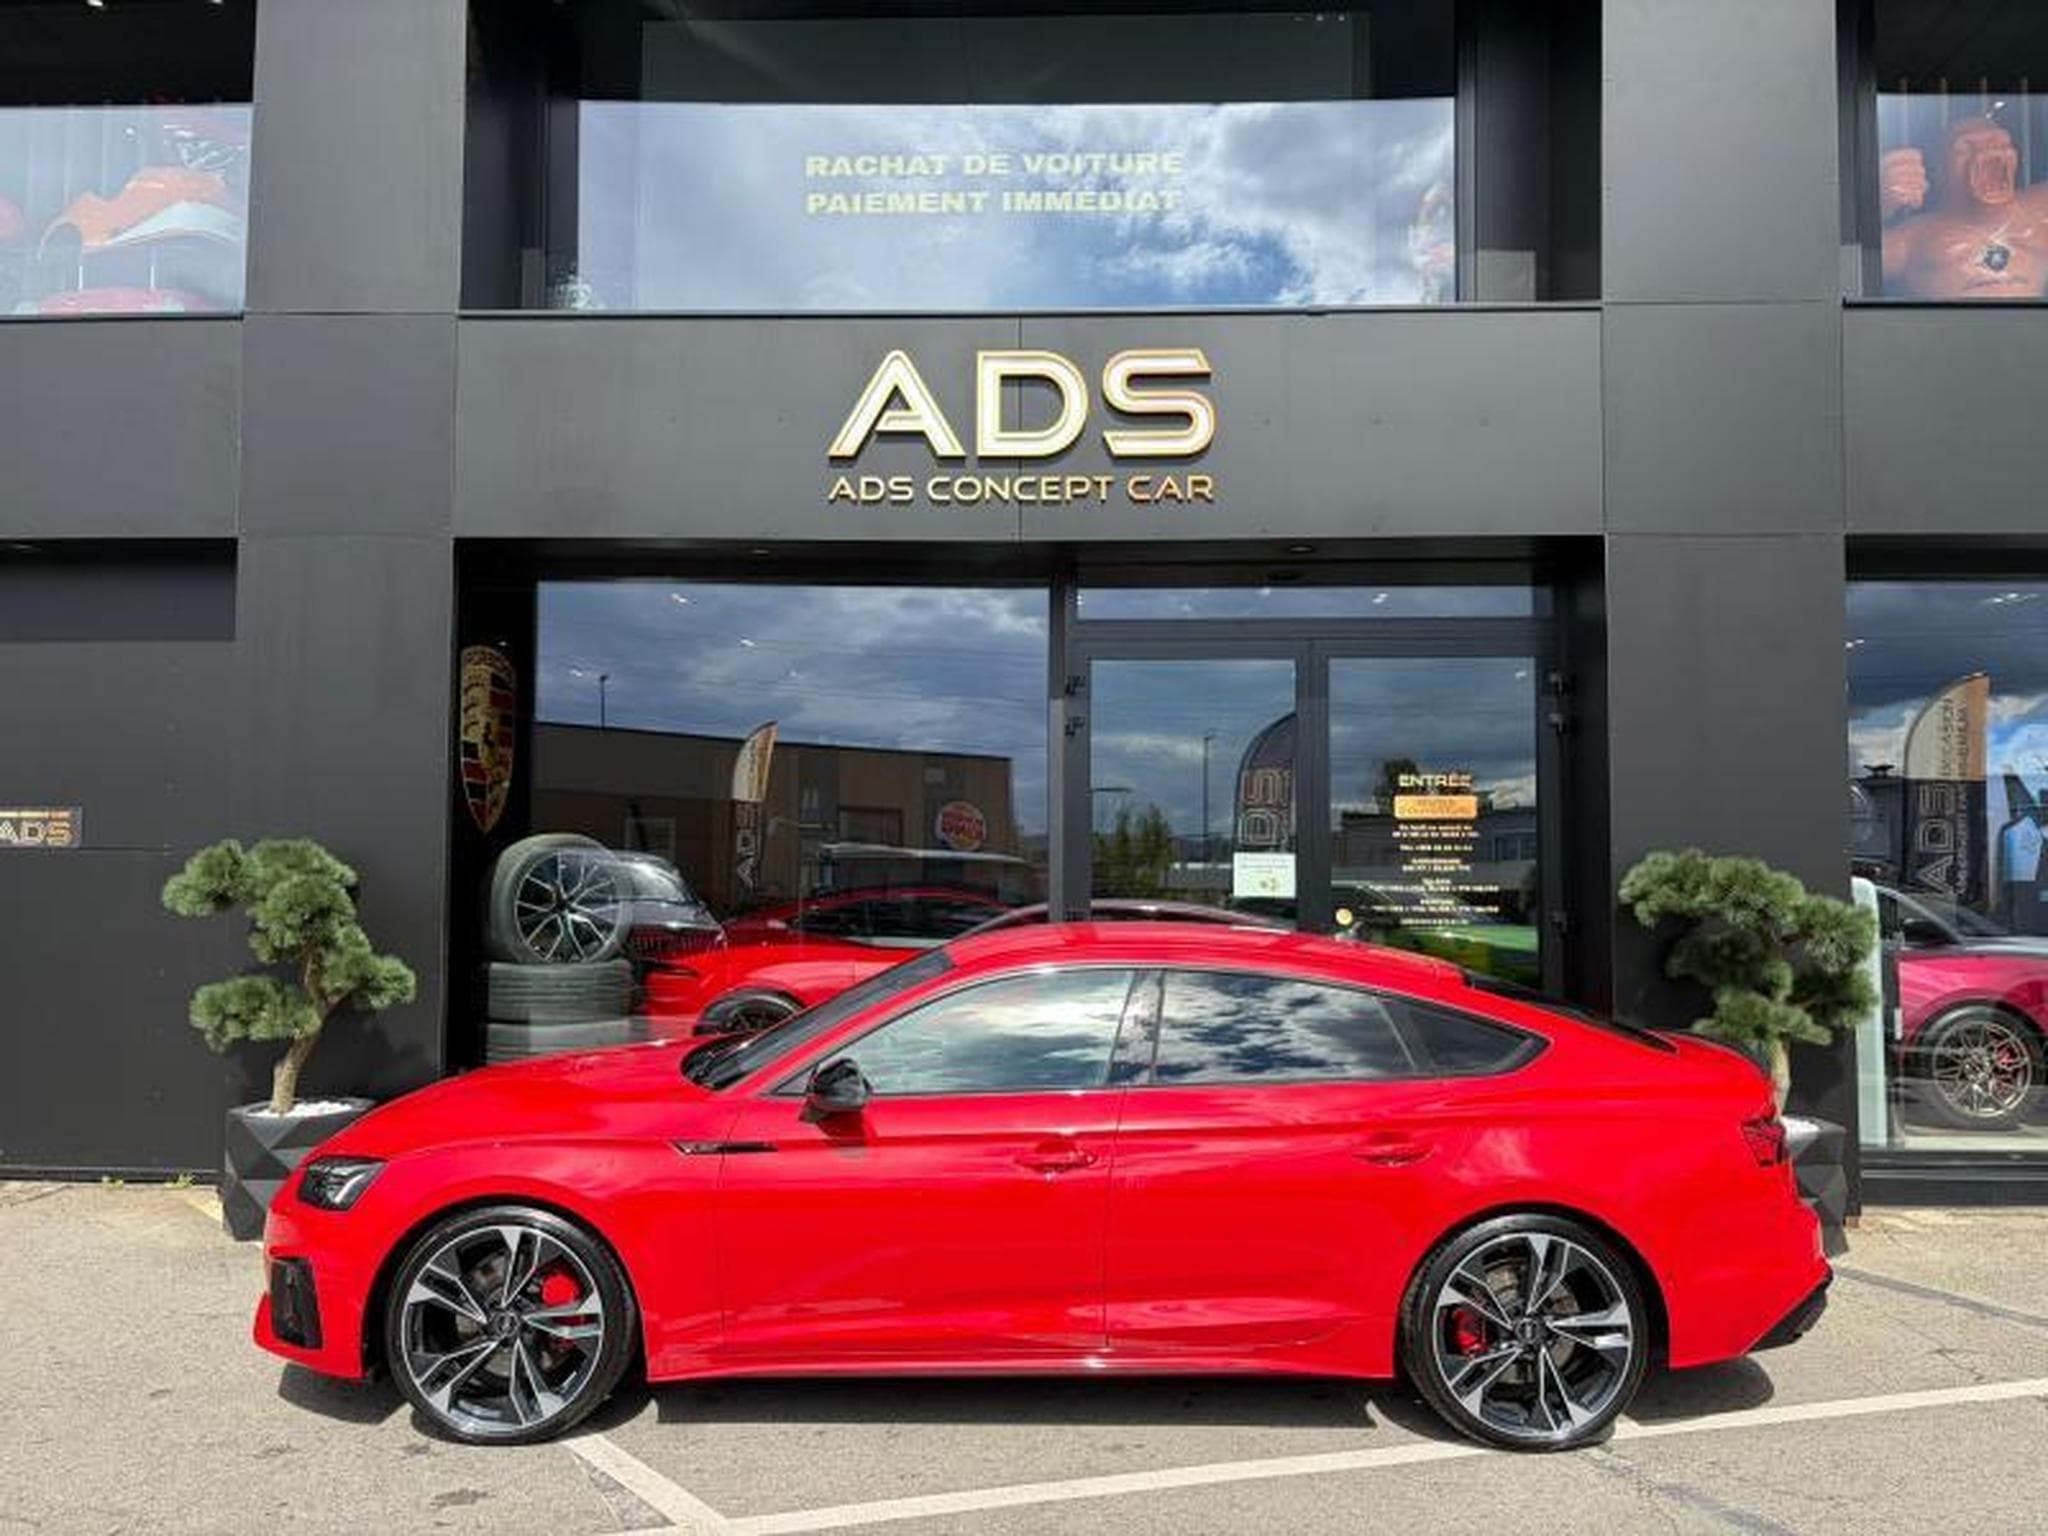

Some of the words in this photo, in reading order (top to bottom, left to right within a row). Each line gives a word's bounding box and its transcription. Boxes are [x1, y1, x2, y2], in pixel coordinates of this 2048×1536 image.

[806, 154, 950, 176] RACHAT
[963, 154, 1011, 175] DE
[1023, 152, 1184, 175] VOITURE
[806, 191, 989, 214] PAIEMENT
[827, 349, 1216, 458] ADS
[828, 474, 914, 502] ADS
[926, 474, 1115, 502] CONCEPT
[1127, 474, 1215, 502] CAR
